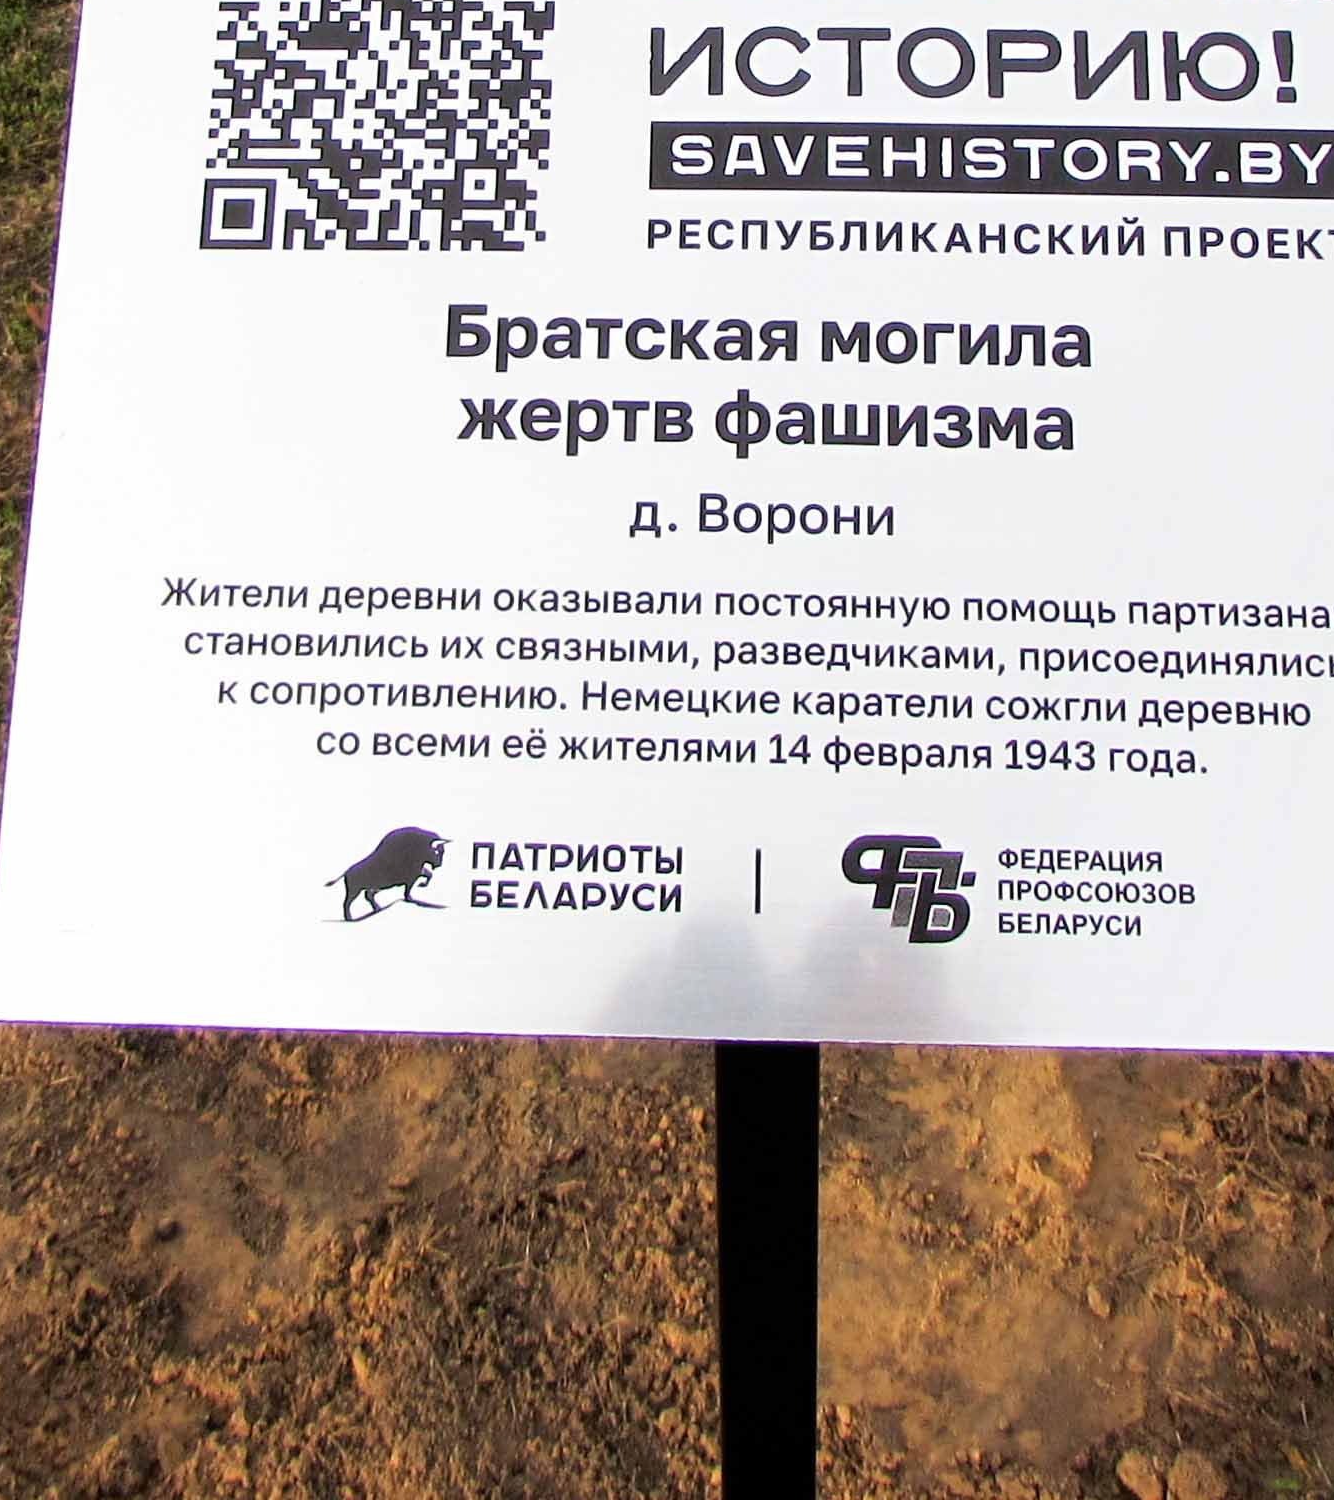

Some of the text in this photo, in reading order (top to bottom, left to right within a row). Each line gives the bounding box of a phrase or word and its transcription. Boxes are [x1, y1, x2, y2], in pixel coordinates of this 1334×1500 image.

[648, 25, 1299, 105] ИСТОРИЮ!
[670, 133, 1333, 186] SAVEHISTORY.BY
[646, 215, 1146, 258] РЕСПУБЛИКАНСКИЙ
[444, 303, 1093, 374] Братская могила
[456, 387, 1075, 460] жертв фашизма
[628, 492, 895, 546] д. Ворони
[161, 577, 309, 611] Жители
[318, 579, 481, 617] деревни
[493, 589, 702, 615] оказывали
[715, 592, 951, 628] постоянную
[963, 598, 1116, 629] помощь
[184, 632, 429, 658] становились
[441, 636, 484, 659] их
[496, 637, 699, 670] связными,
[714, 641, 1005, 677] разведчиками,
[218, 680, 1311, 732] к сопротивлению. Немецкие каратели сожгли деревню
[316, 728, 1208, 778] со всеми её жителями 14 февраля 1943 года.
[472, 842, 683, 875] ПАТРИОТЫ
[997, 847, 1164, 875] ФЕДЕРАЦИЯ
[470, 880, 682, 913] БЕЛАРУСИ
[997, 879, 1197, 905] ПРОФСОЮЗОВ
[997, 912, 1142, 937] БЕЛАРУСИ
